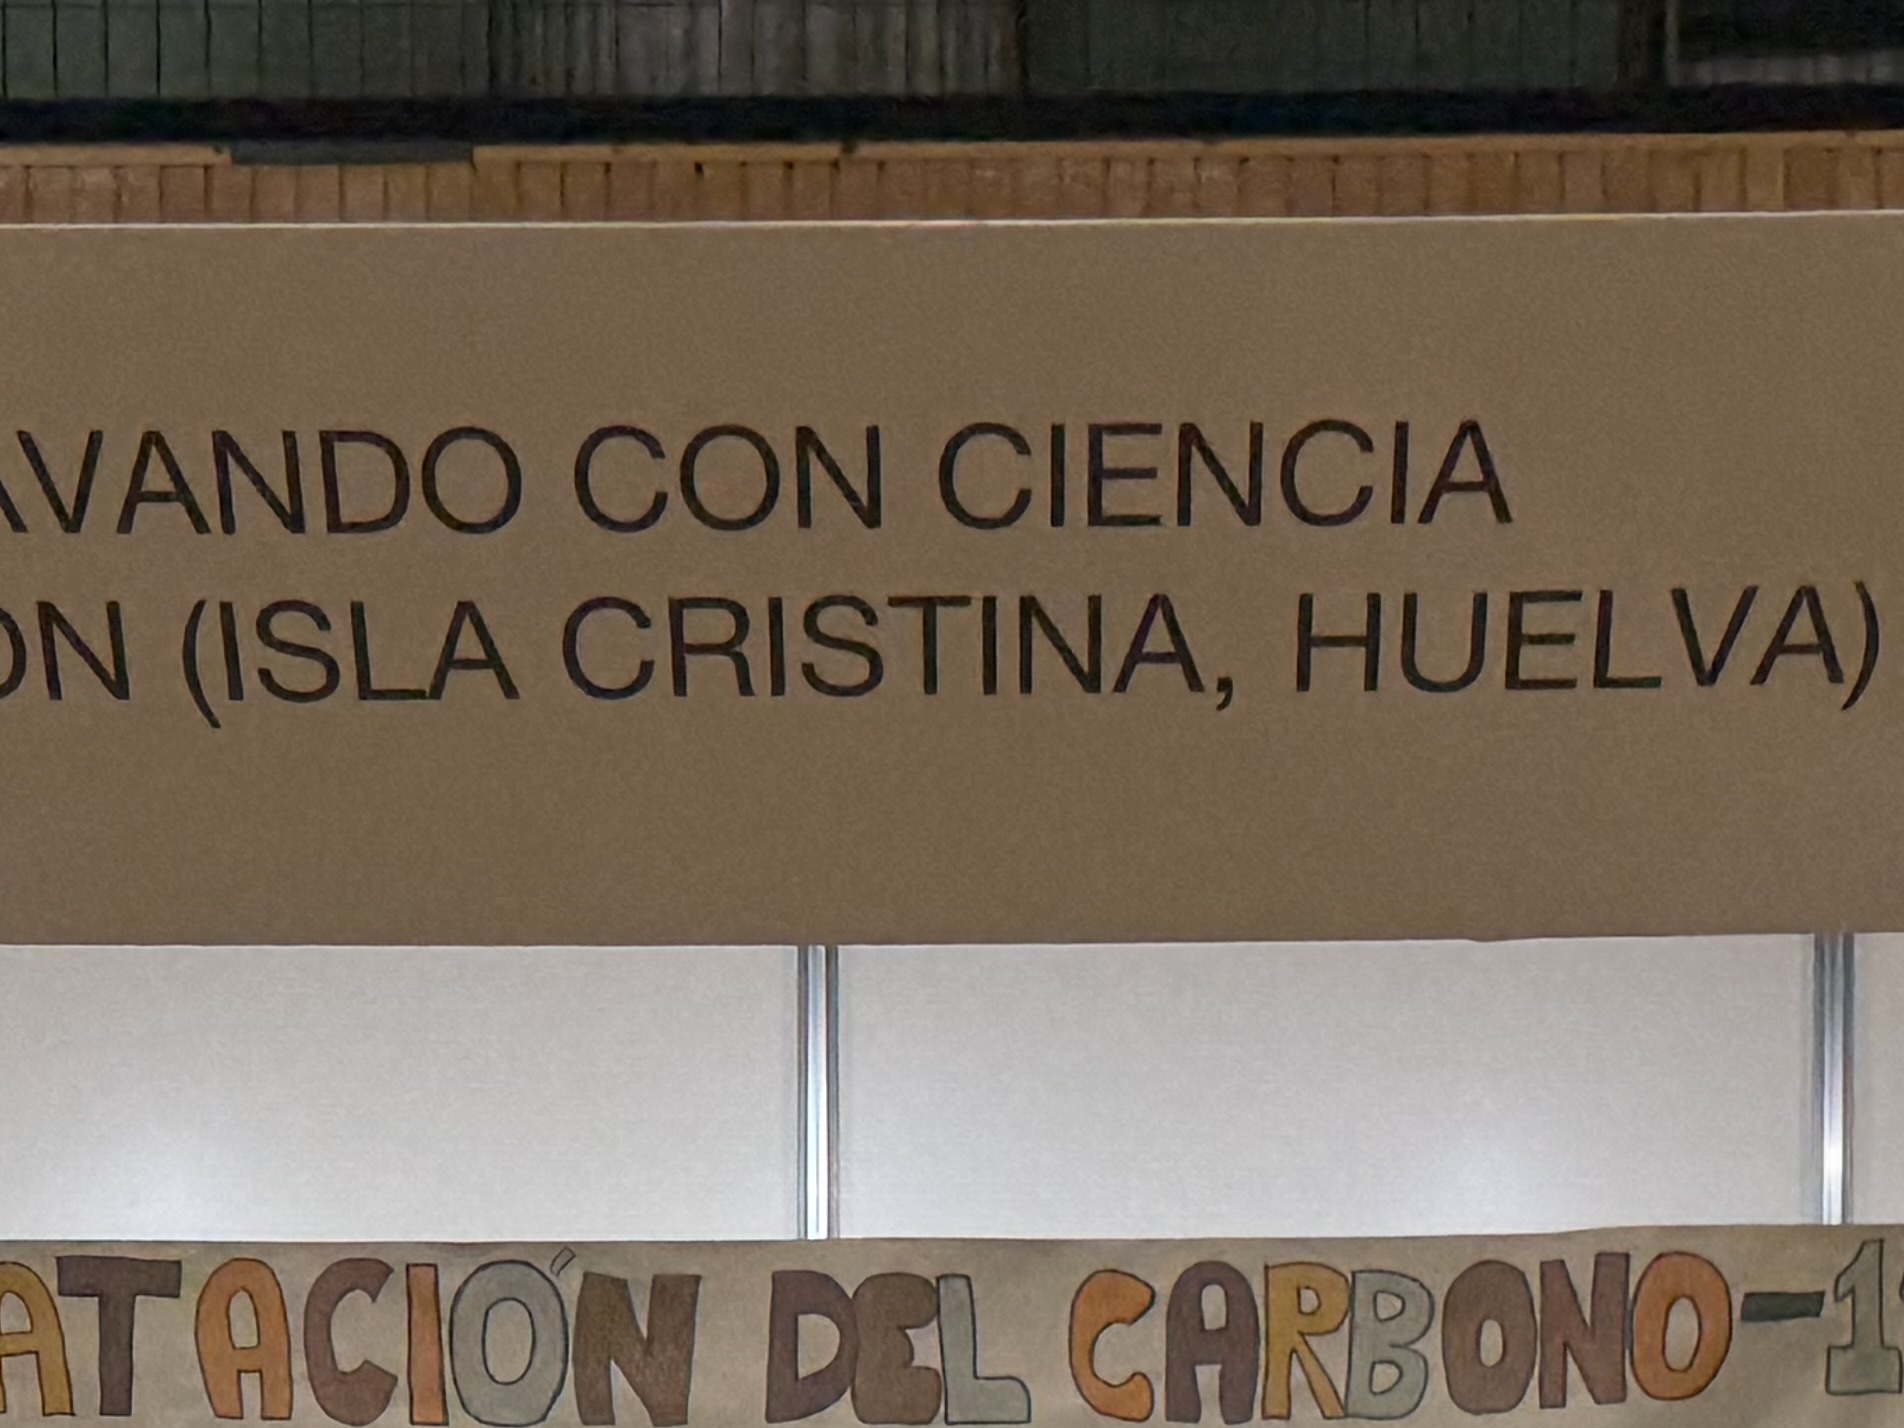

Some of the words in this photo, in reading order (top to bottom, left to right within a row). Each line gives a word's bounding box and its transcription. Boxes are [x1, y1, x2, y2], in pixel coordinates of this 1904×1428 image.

[573, 424, 885, 532] CON
[937, 419, 1514, 530] CIENCIA
[181, 599, 521, 730] (ISLA
[560, 592, 1236, 710] CRISTINA,
[1294, 580, 1882, 710] HUELVA)
[764, 1270, 1031, 1427] DEL
